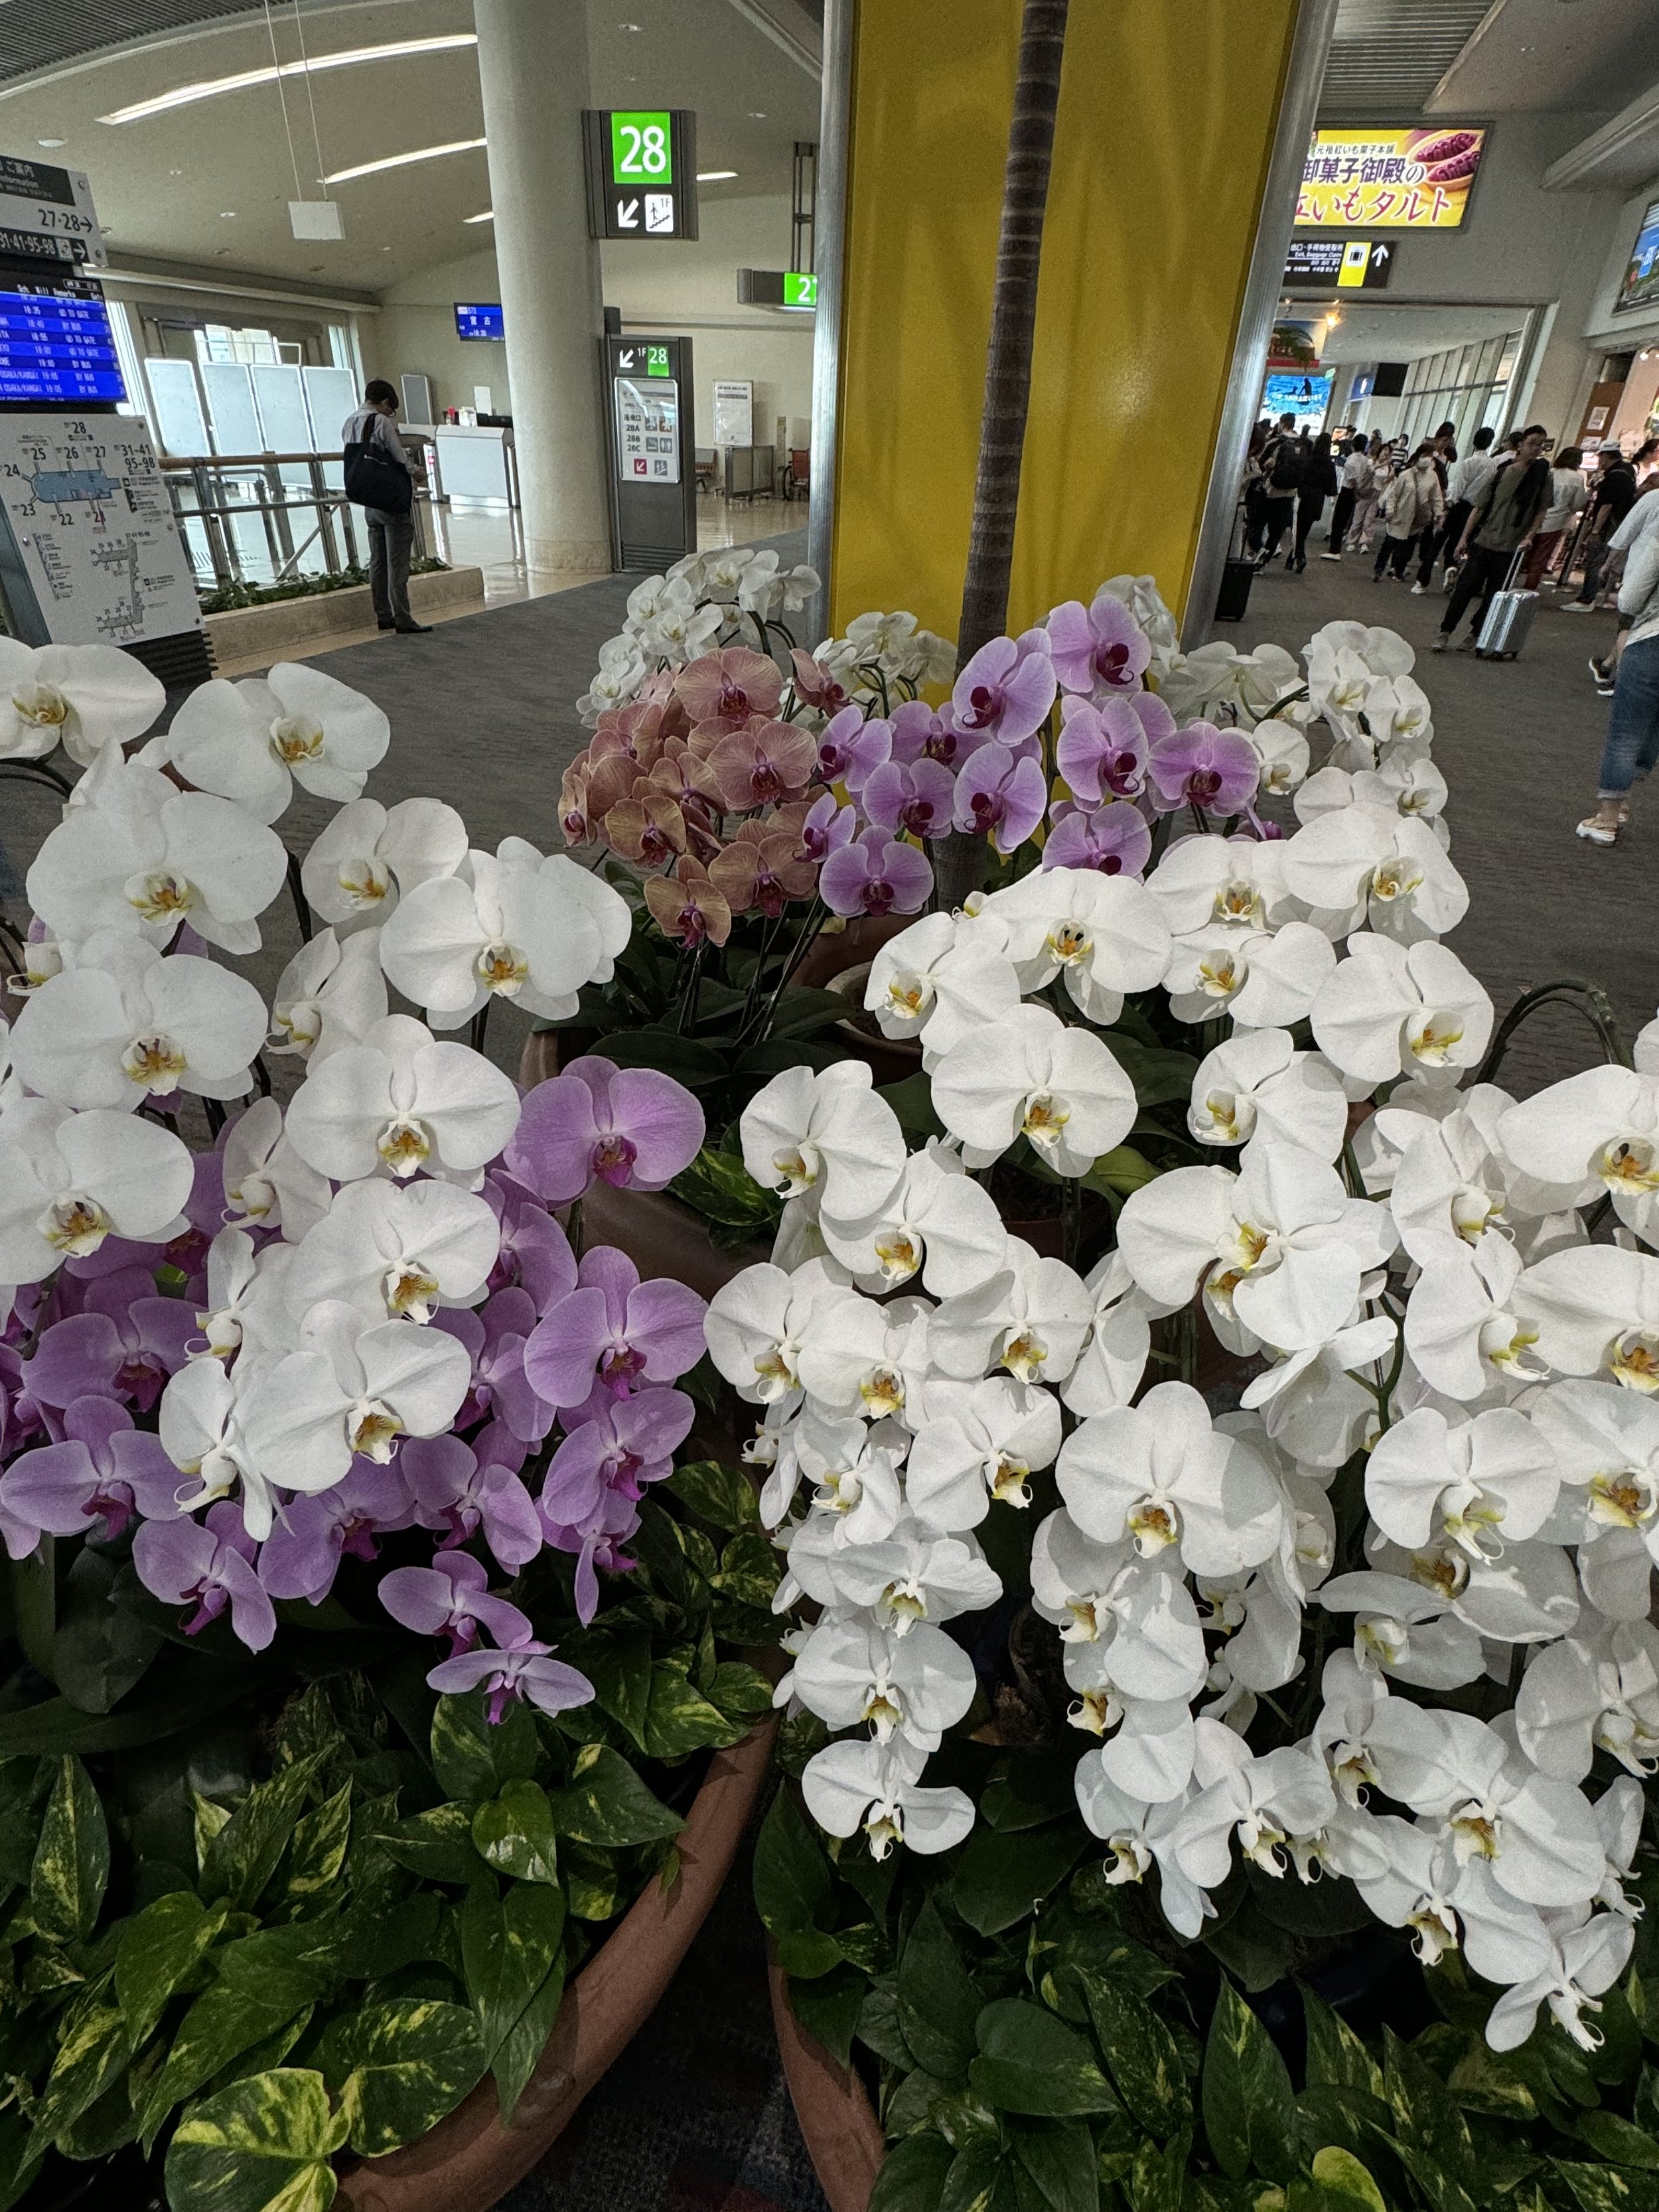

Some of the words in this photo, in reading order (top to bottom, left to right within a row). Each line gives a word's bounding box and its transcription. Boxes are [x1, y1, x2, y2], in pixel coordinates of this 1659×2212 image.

[620, 126, 666, 173] 28
[660, 198, 670, 208] 1F
[638, 348, 646, 357] 1F
[649, 348, 667, 364] 28
[72, 421, 86, 433] 28
[31, 447, 46, 460] 25
[64, 447, 78, 459] 26
[94, 446, 106, 458] 27
[5, 464, 20, 476] 24
[21, 504, 35, 516] 23
[59, 514, 74, 525] 22
